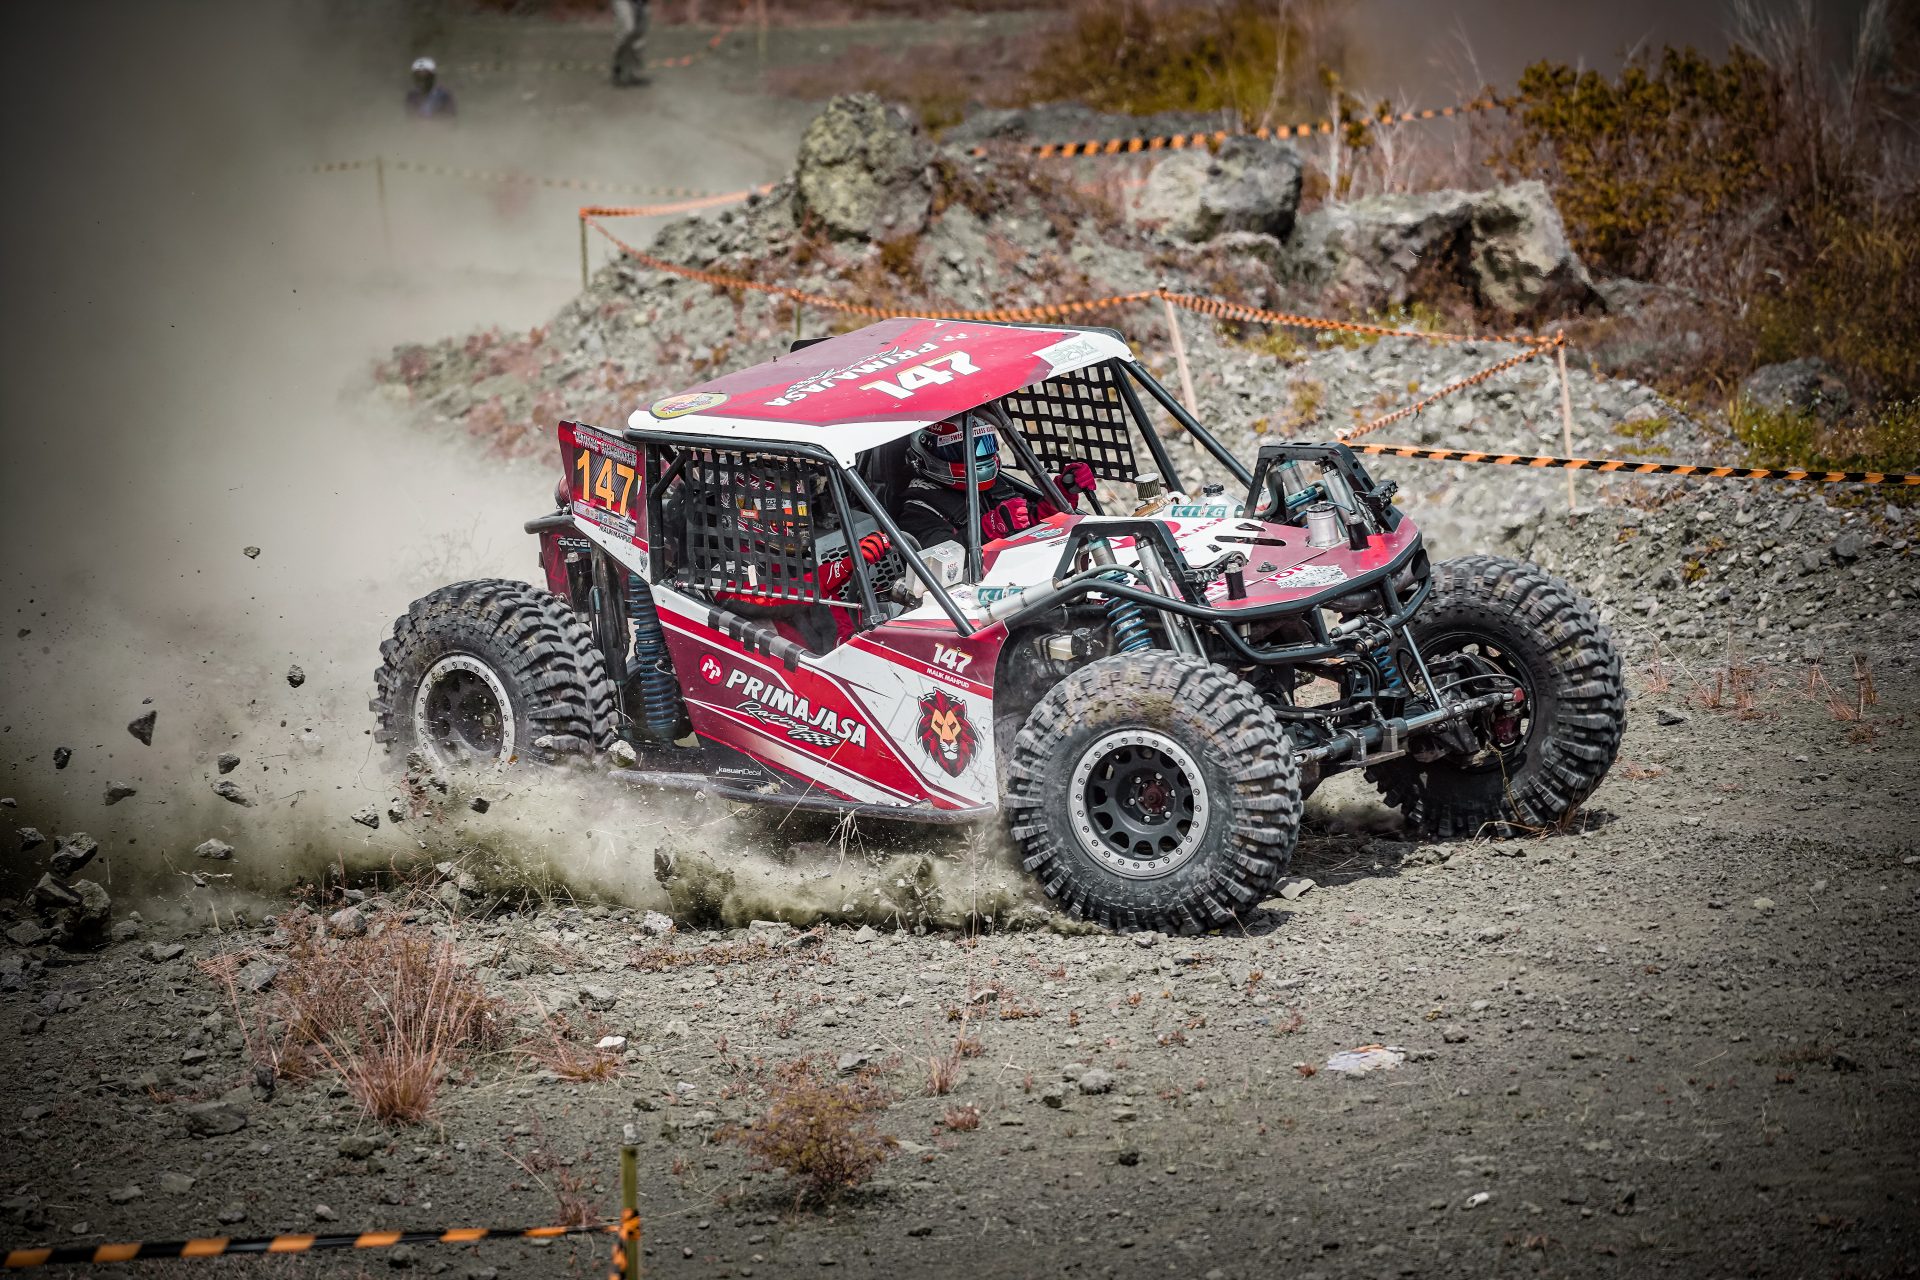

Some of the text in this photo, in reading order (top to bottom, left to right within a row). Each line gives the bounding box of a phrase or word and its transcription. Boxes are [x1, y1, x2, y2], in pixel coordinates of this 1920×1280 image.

[763, 341, 940, 407] PRIMAJASA
[858, 350, 982, 400] 147
[577, 449, 635, 517] 147
[1173, 506, 1225, 517] KING
[926, 667, 970, 689] MALIK MAHPUD
[932, 642, 973, 673] 147
[725, 668, 867, 748] PRIMAJASA
[736, 699, 810, 736] Racing
